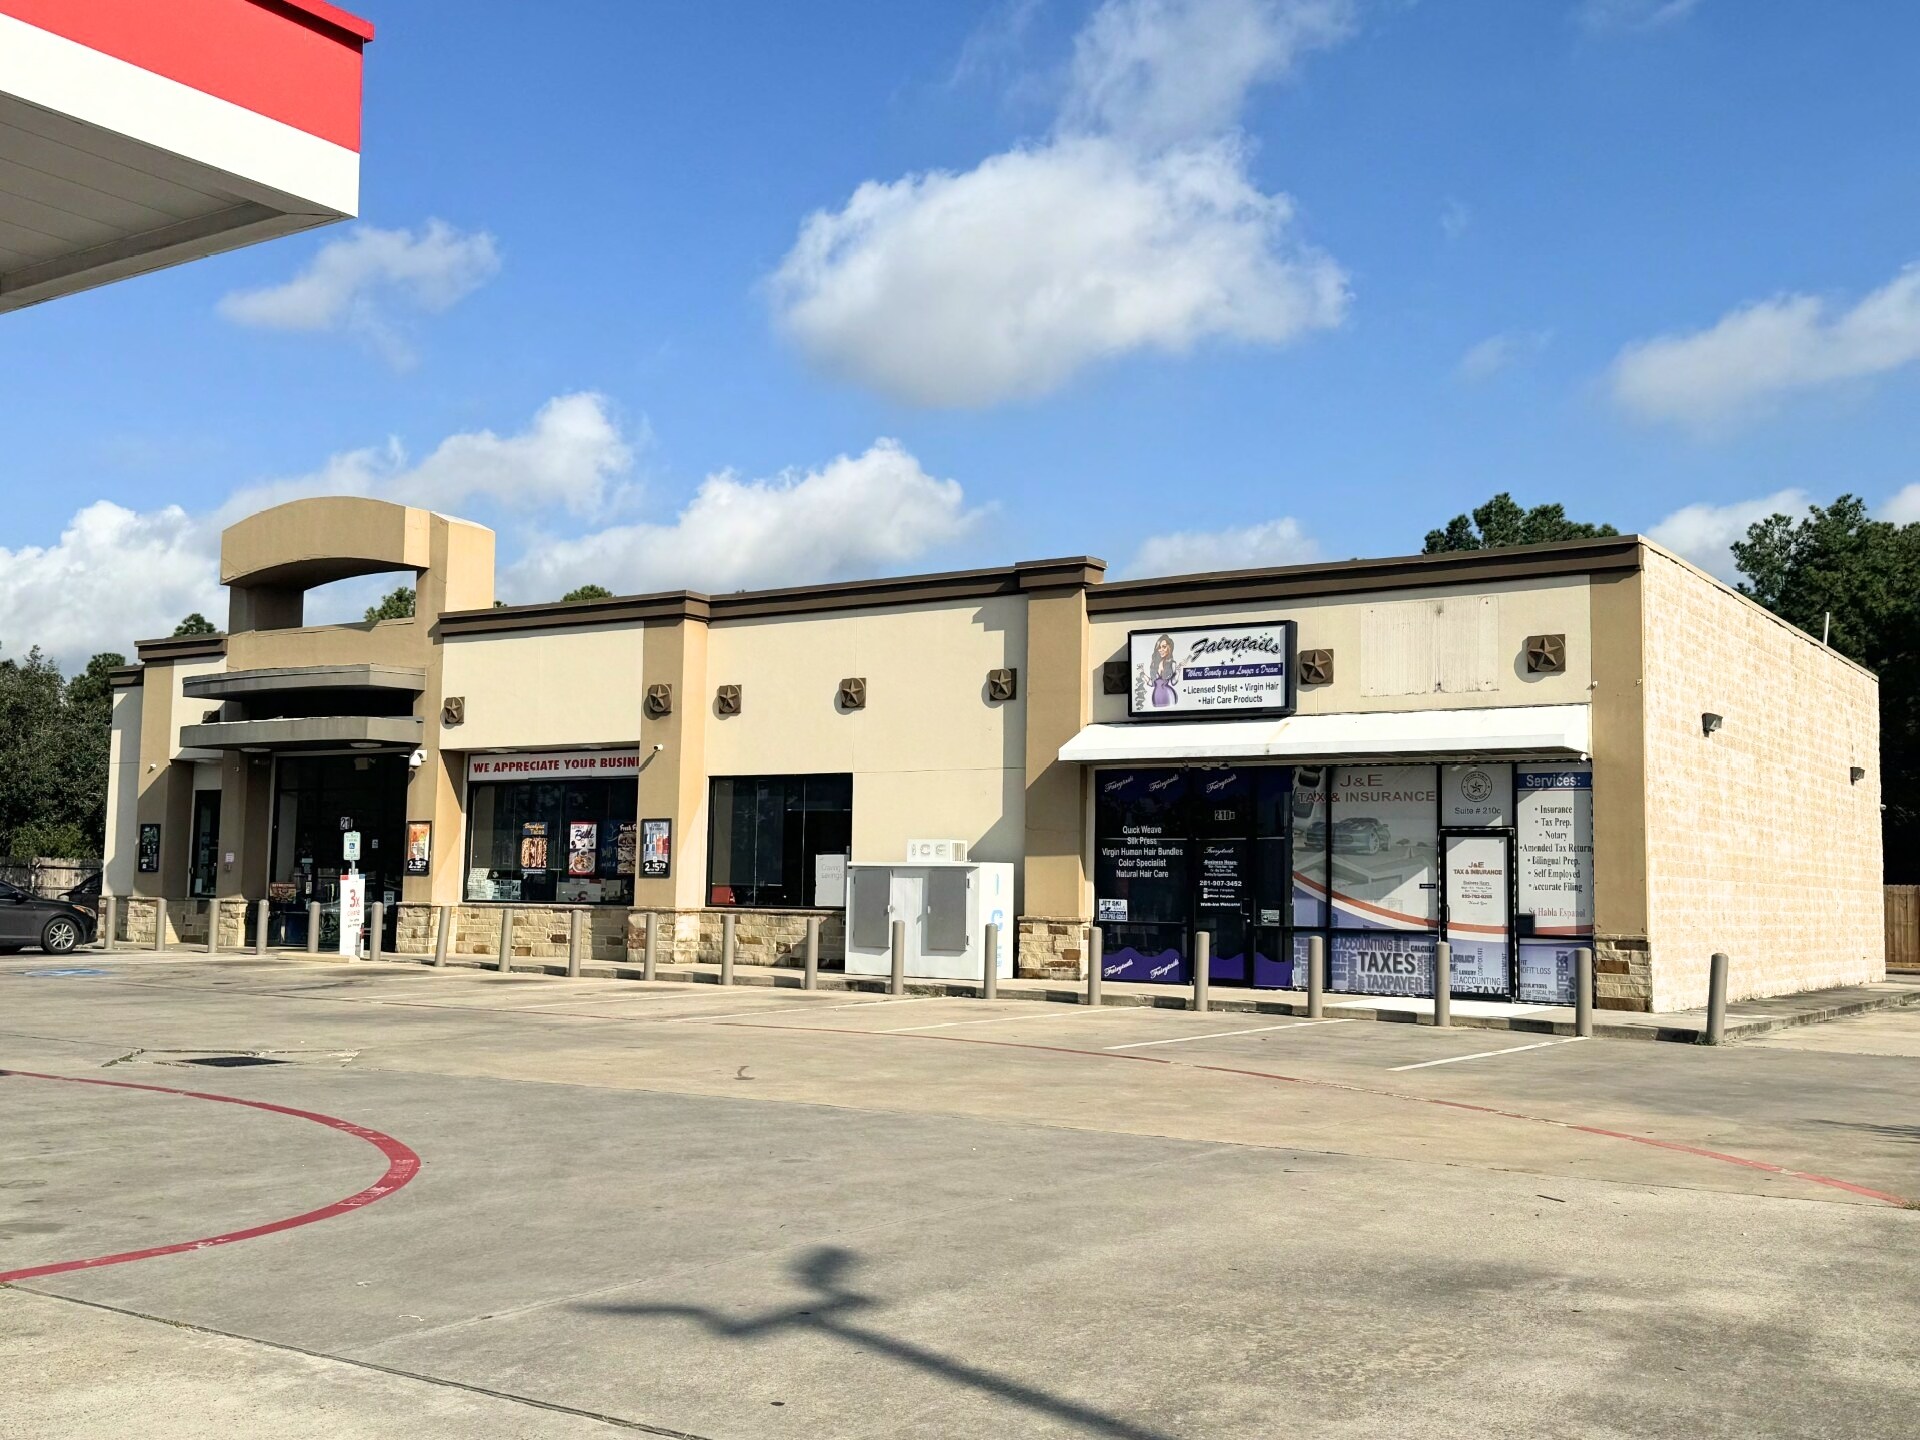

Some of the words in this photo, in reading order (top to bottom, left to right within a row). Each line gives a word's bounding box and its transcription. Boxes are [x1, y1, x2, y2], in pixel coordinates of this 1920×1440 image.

[1190, 636, 1281, 662] Fairytails
[1236, 666, 1256, 677] Longer
[1187, 684, 1215, 694] Licensed
[1217, 684, 1238, 694] Stylist
[1245, 682, 1264, 693] Virgin
[1266, 682, 1279, 691] Hair
[1202, 696, 1215, 704] Hair
[1217, 695, 1232, 704] Care
[1233, 695, 1263, 703] Products
[474, 763, 489, 773] WE
[493, 760, 560, 773] APPRECIATE
[564, 758, 596, 770] YOUR
[1340, 773, 1384, 787] J&E
[1526, 774, 1581, 787] Services:
[1298, 792, 1326, 803] TAX
[1331, 792, 1341, 803] &
[1345, 790, 1436, 802] INSURANCE
[1454, 807, 1474, 815] Suite
[1540, 805, 1573, 814] Insurance
[1541, 817, 1552, 826] Tax
[1554, 818, 1572, 828] Prep.
[1122, 825, 1140, 834] Quick
[1141, 825, 1162, 834] Weave
[1127, 837, 1138, 845] Silk
[1139, 837, 1157, 845] Press
[1545, 830, 1568, 842] Notary
[911, 843, 947, 856] ICE
[1101, 847, 1120, 857] Virgin
[1121, 848, 1143, 856] Human
[1143, 847, 1157, 855] Hair
[1157, 847, 1184, 856] Bundles
[1522, 843, 1553, 852] Amended
[1555, 843, 1567, 852] Tax
[1118, 859, 1136, 867] Color
[1136, 858, 1167, 868] Specialist
[1532, 856, 1561, 867] Bilingual
[1563, 856, 1581, 868] Prep.
[1115, 869, 1138, 878] Natural
[1139, 869, 1153, 878] Hair
[1153, 869, 1169, 878] Care
[1533, 868, 1546, 878] Self
[1547, 869, 1581, 881] Employed
[1532, 882, 1562, 891] Accurate
[1563, 882, 1583, 893] Filing
[1538, 907, 1558, 917] Habla
[1339, 937, 1393, 952] ACCOUNTING
[1357, 951, 1417, 975] TAXES
[1536, 967, 1552, 975] LOSS
[1365, 974, 1424, 992] TAXPAYER
[1458, 976, 1501, 986] ACCOUNTING
